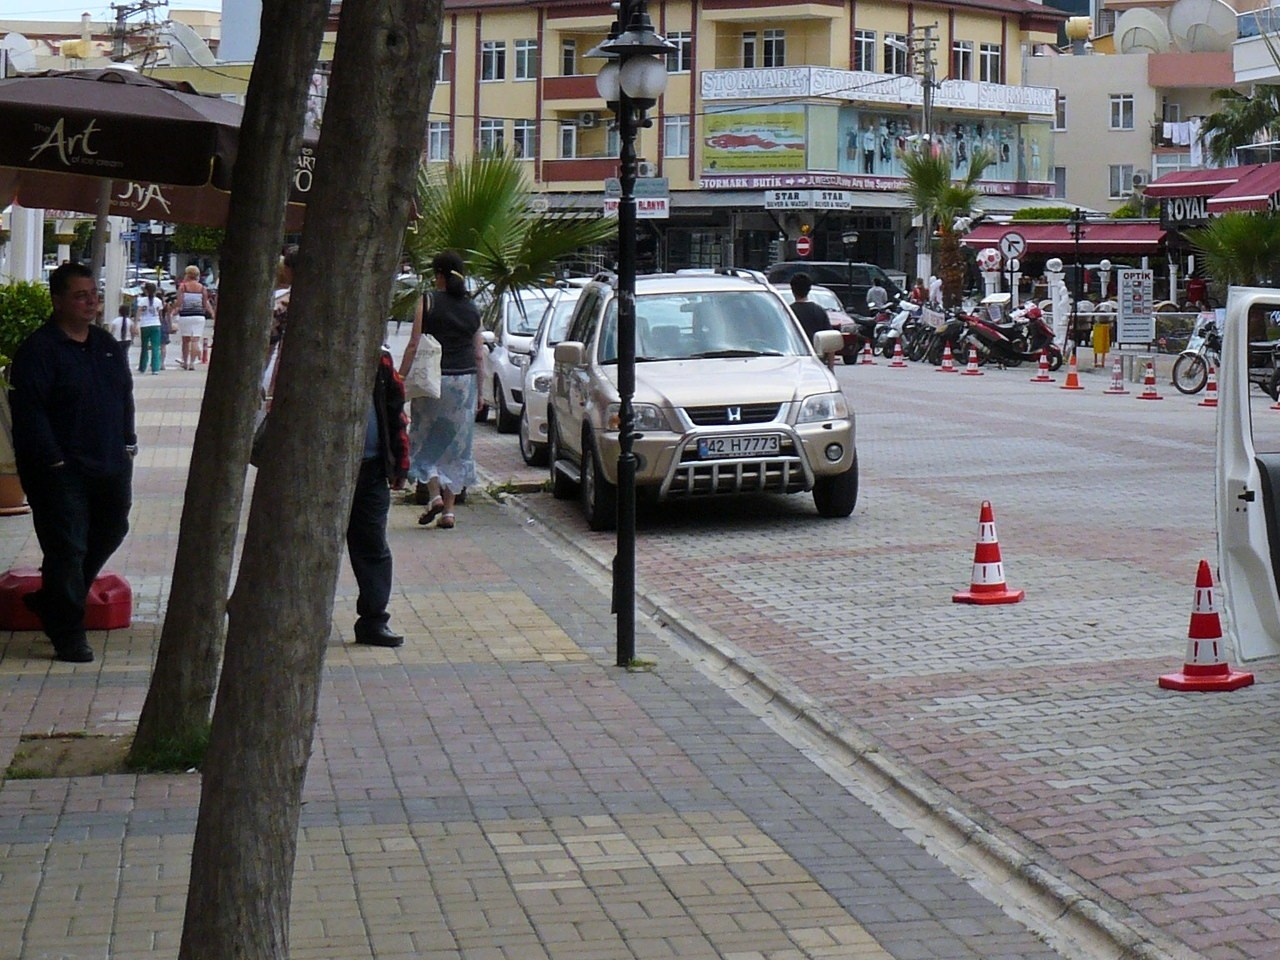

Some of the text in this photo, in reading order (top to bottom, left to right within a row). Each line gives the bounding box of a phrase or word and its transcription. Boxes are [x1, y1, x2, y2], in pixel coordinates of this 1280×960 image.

[29, 117, 102, 167] Art
[700, 178, 748, 189] STORMARK
[775, 192, 800, 200] STAR
[822, 192, 843, 201] STAR
[1167, 197, 1208, 222] ROYAL
[1123, 272, 1151, 280] OPTİK
[708, 440, 724, 452] 42
